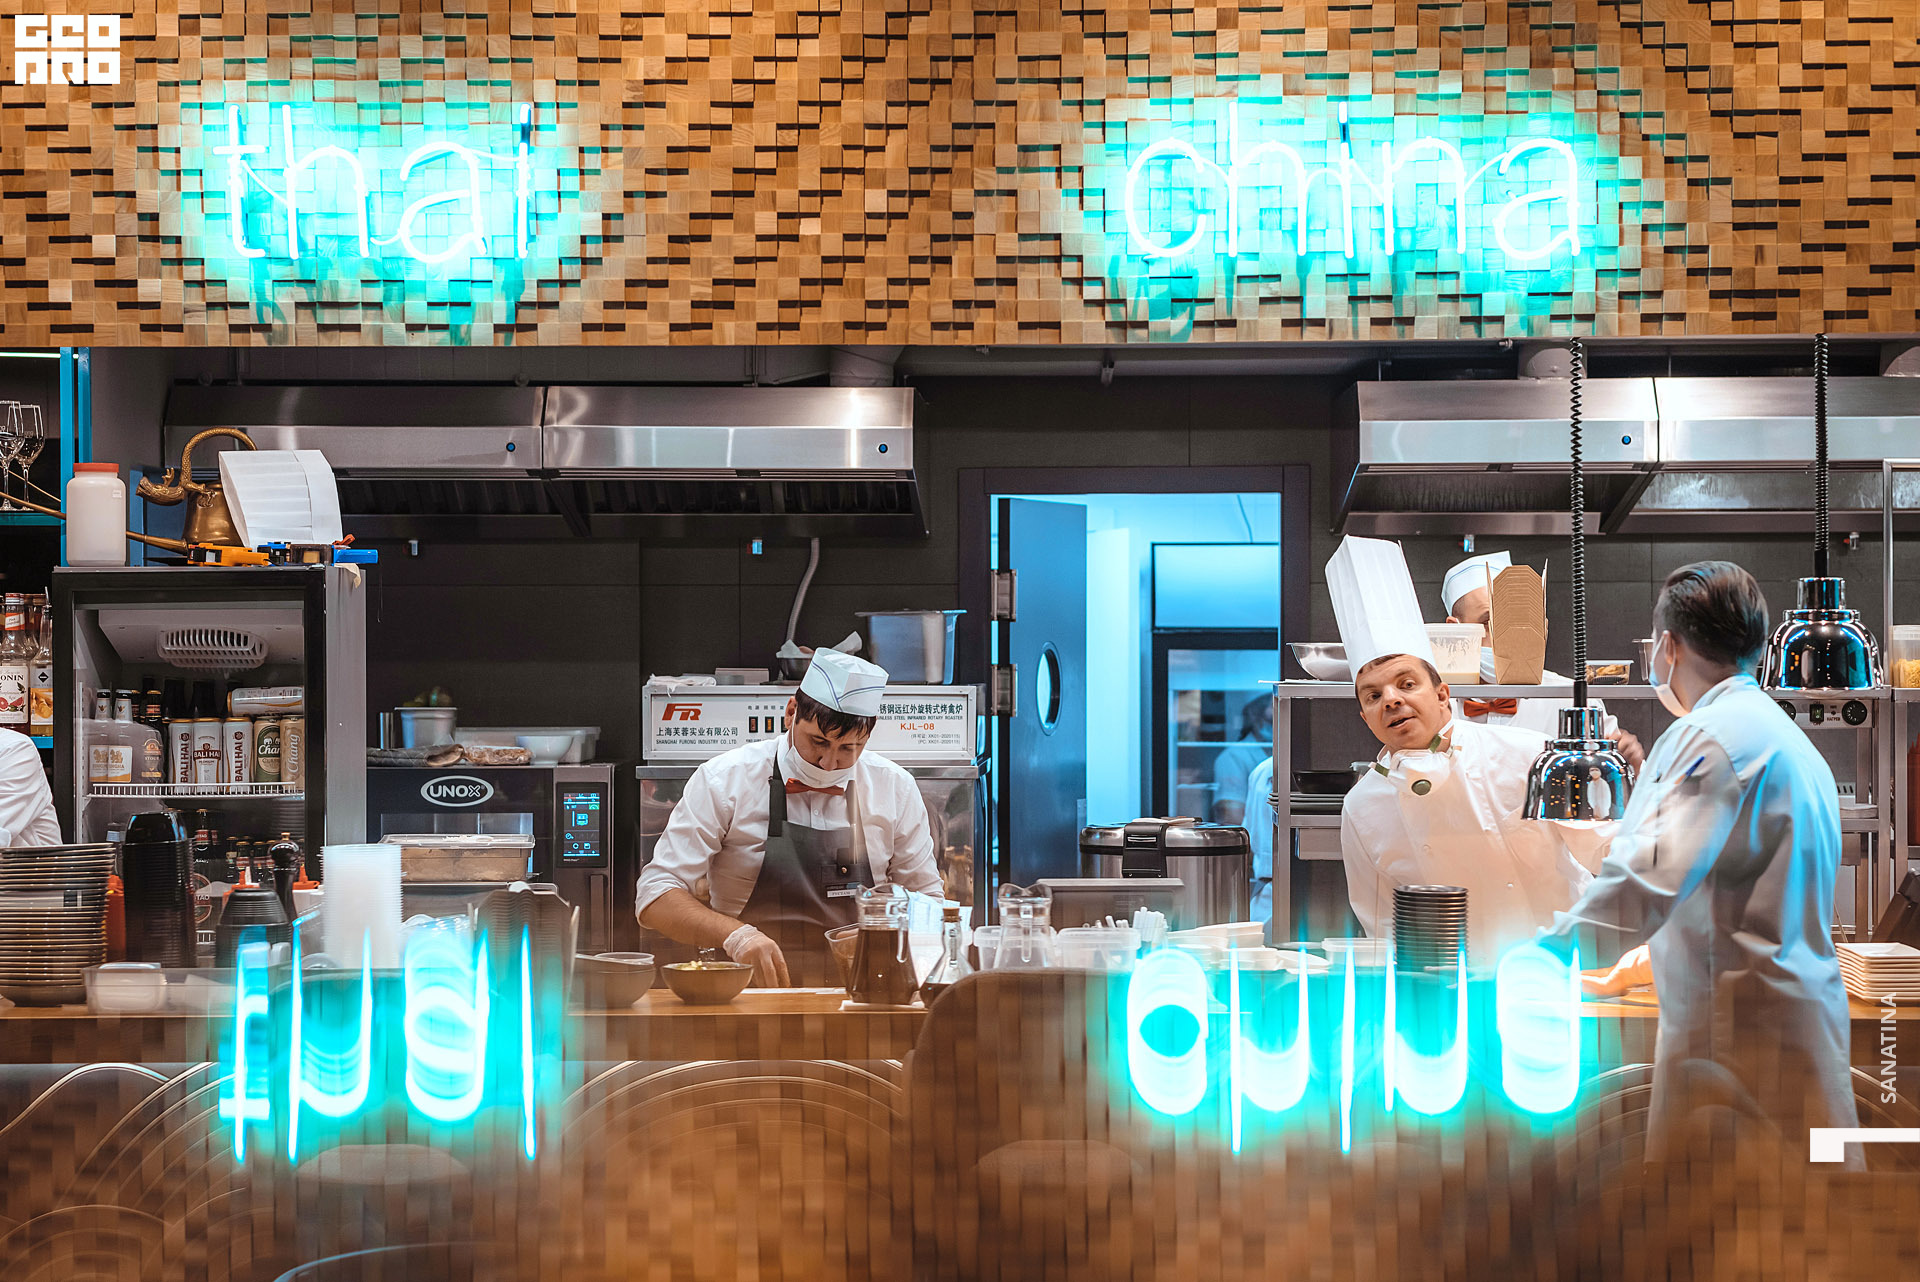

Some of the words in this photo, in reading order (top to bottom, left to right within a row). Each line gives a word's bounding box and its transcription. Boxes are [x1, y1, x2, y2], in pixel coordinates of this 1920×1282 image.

[213, 103, 532, 263] thai
[1125, 101, 1580, 260] china
[878, 704, 963, 714] 锈钢远红外旋转式烤禽炉
[656, 727, 738, 737] 上海芙蓉实业有限公司
[235, 742, 243, 759] HAI
[235, 761, 243, 781] BALI
[429, 785, 481, 798] UNOX
